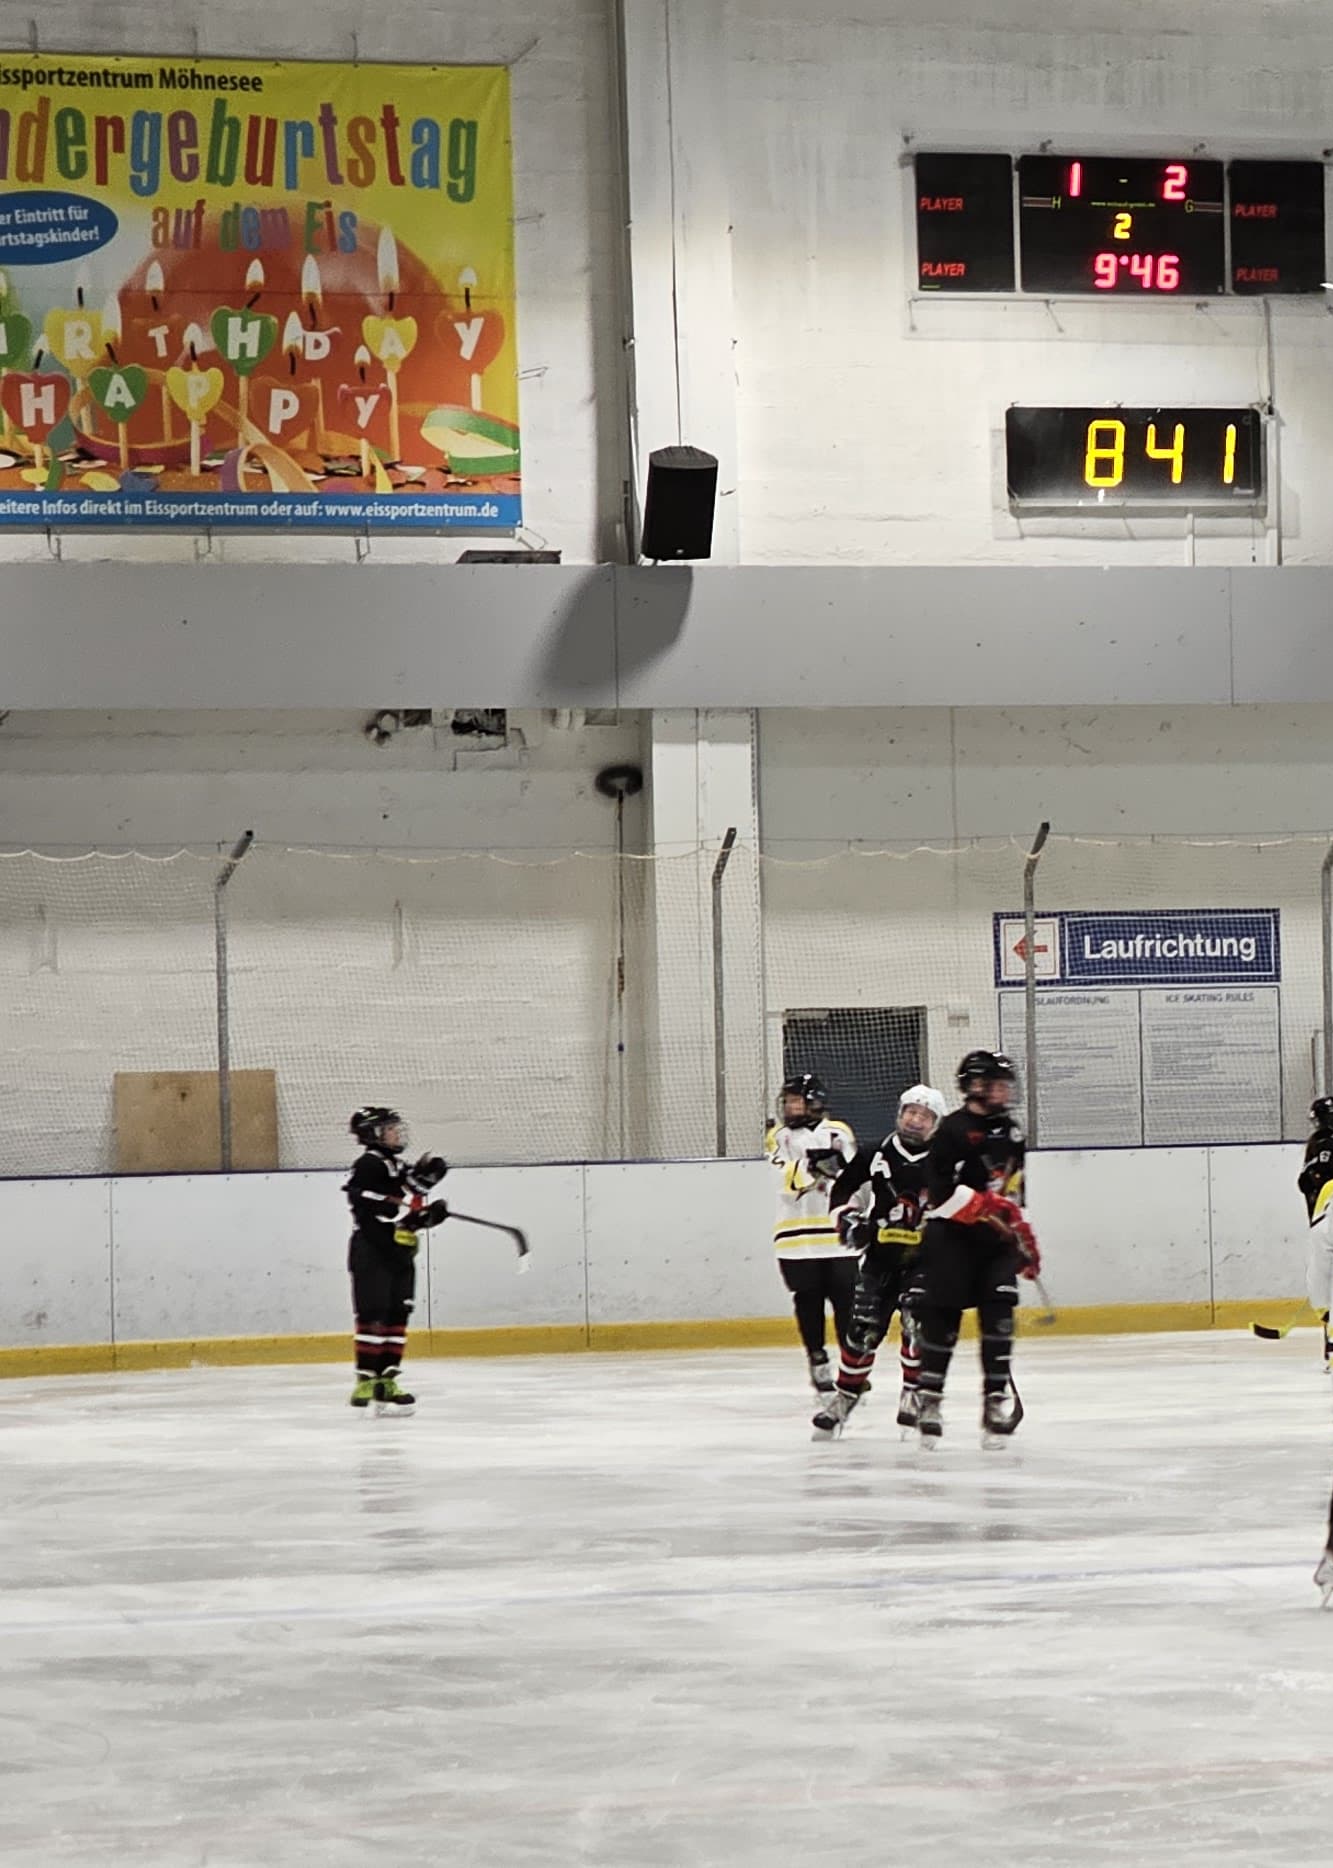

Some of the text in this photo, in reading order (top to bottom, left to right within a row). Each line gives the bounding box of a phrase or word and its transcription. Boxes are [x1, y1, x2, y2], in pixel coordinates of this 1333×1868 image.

[0, 67, 263, 92] ssportzentrum Möhnesee
[1068, 161, 1082, 197] 1
[1161, 164, 1189, 201] 2
[14, 207, 66, 224] Eintritt
[67, 205, 89, 221] für
[920, 197, 964, 211] PLAYER
[1235, 203, 1277, 218] PLAYER
[0, 225, 100, 248] rtstagskinder!
[151, 199, 358, 254] auf dem Eis
[1113, 212, 1133, 240] 2
[921, 262, 966, 277] PLAYER
[1236, 267, 1279, 282] PLAYER
[42, 499, 78, 516] Infos
[79, 500, 122, 516] direkt
[124, 500, 143, 516] im
[145, 501, 258, 519] Eissportzentrum
[260, 502, 294, 517] oder
[294, 502, 323, 517] auf:
[324, 502, 499, 519] www.eissportzentrum.de
[1083, 932, 1257, 961] Laufrichtung
